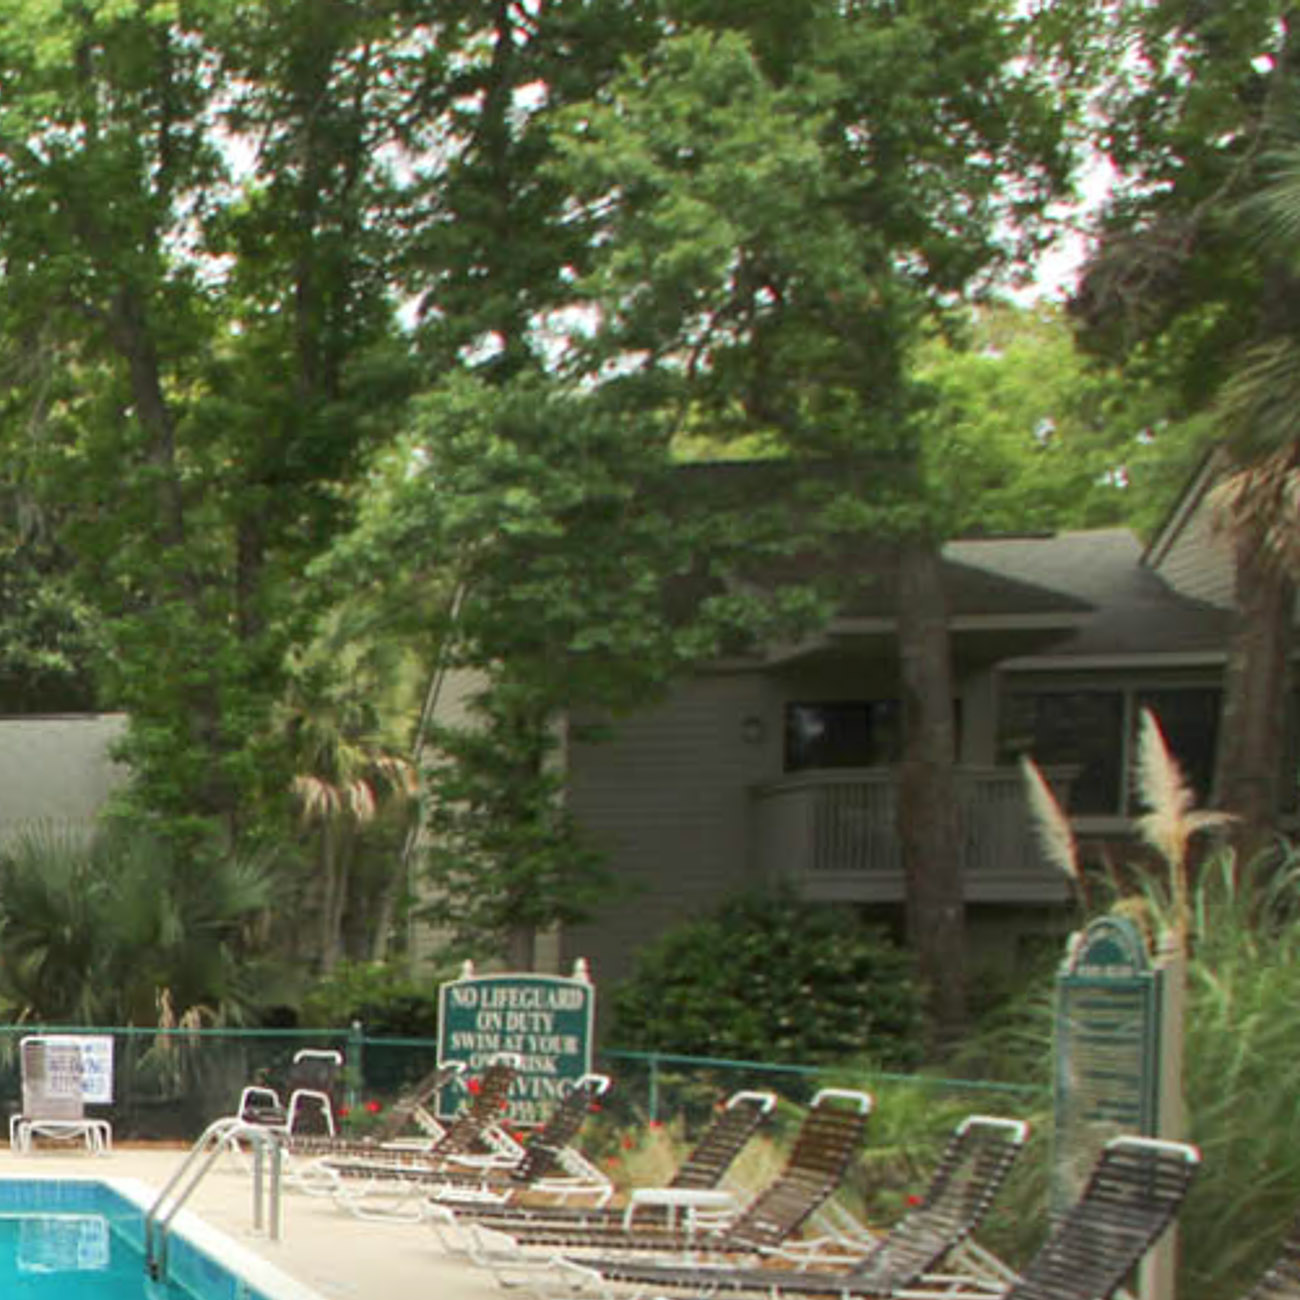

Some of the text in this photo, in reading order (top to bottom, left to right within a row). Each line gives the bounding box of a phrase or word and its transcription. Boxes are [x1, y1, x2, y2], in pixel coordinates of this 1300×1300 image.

[451, 986, 584, 1010] NO LIFEGUARD
[476, 1011, 554, 1032] ON DUTY
[451, 1032, 579, 1055] SWIM AT YOUR
[506, 1074, 574, 1099] IVING
